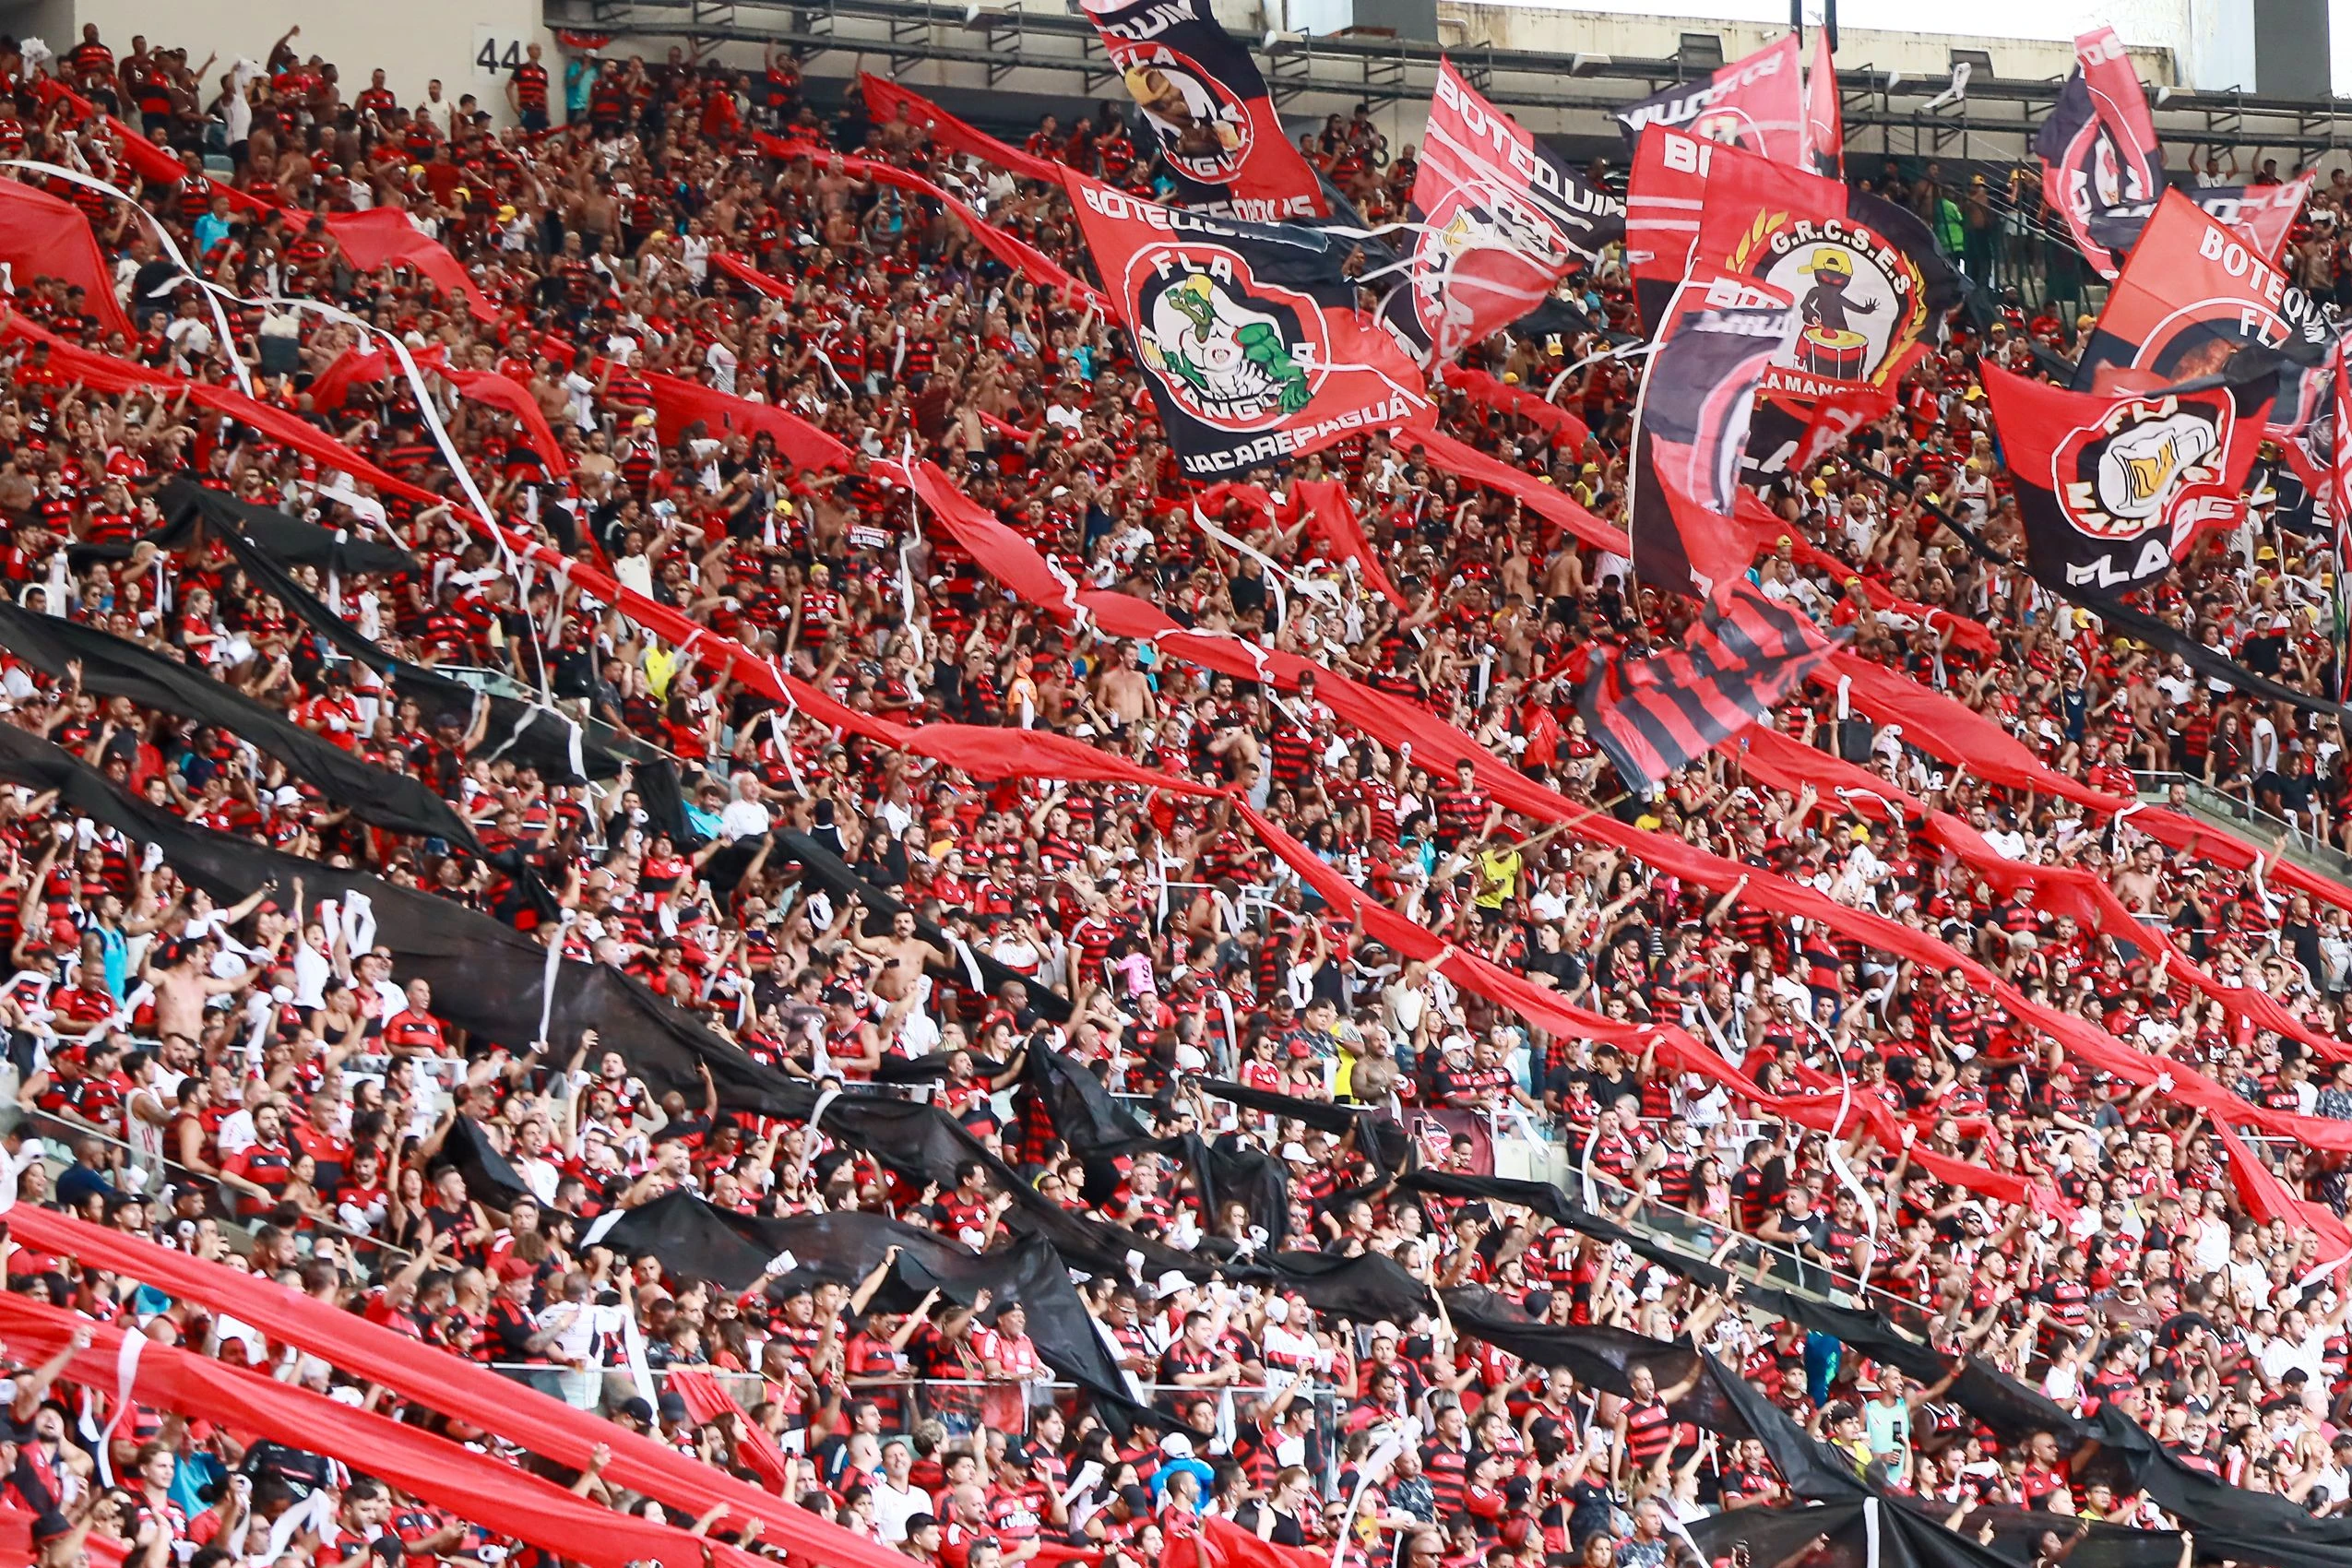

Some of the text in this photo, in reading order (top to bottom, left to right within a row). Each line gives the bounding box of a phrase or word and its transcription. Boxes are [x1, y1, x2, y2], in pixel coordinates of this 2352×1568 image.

[477, 38, 520, 75] 44
[1110, 46, 1178, 77] FLA
[1435, 66, 1627, 218] BOTEQUIM
[1149, 250, 1232, 285] FLA
[2239, 307, 2274, 348] FL
[1183, 388, 1413, 474] JACAREPAGUÁ
